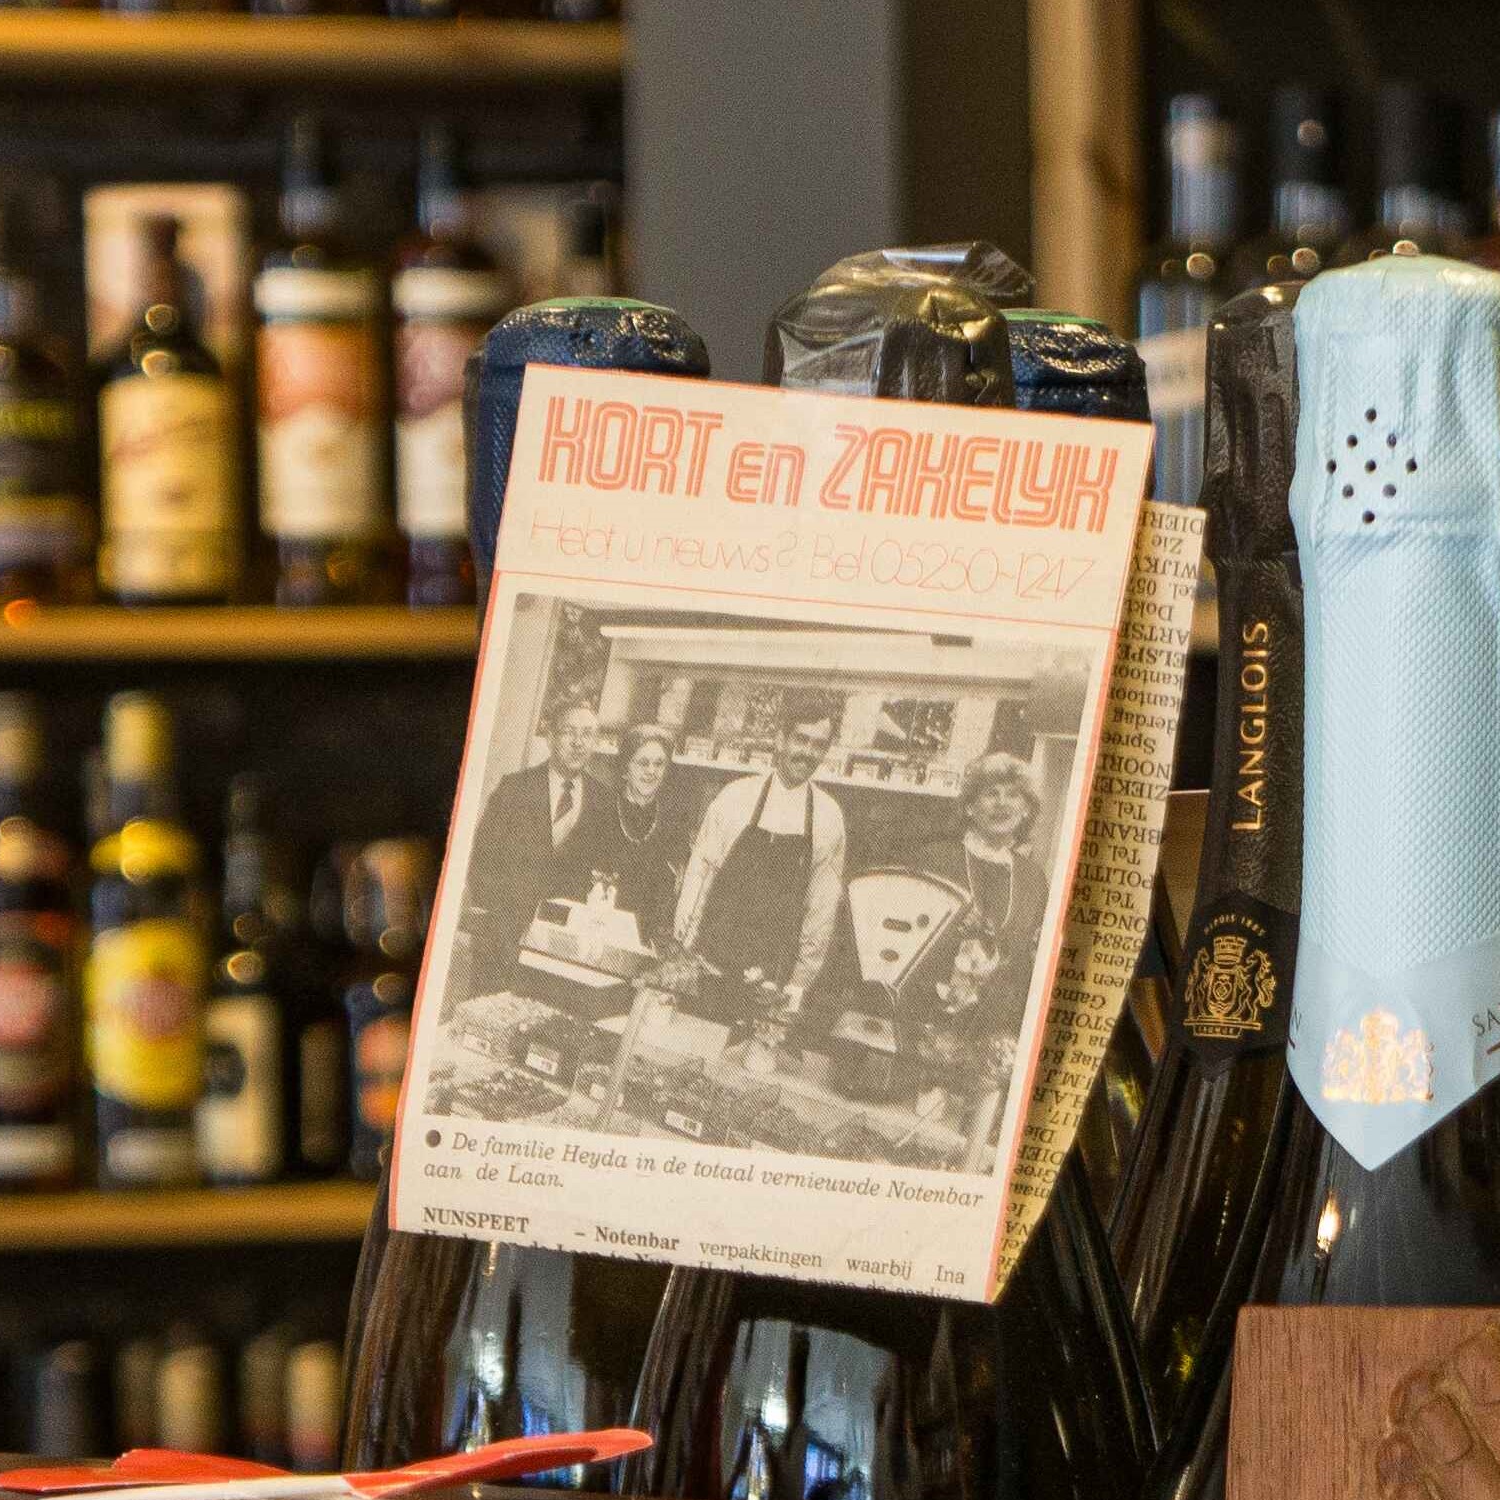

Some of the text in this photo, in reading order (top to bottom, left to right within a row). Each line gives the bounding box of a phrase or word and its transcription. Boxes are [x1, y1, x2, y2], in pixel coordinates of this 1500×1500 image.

[537, 396, 1119, 534] KORT en ZAKELYK
[531, 507, 617, 560] Hebt
[622, 536, 645, 563] u
[653, 529, 798, 573] nieuws?
[810, 533, 867, 581] Bel
[1231, 621, 1269, 831] LANGLOIS
[423, 1160, 565, 1189] aan de Laan.
[451, 1131, 985, 1209] De familie Heyda in de totaal vernieuwde Notenbar
[422, 1205, 531, 1234] NUNSPEET
[594, 1225, 681, 1252] Notenbar
[698, 1240, 824, 1269] verpakkingen
[845, 1256, 913, 1281] waarbij
[933, 1263, 966, 1286] Ina
